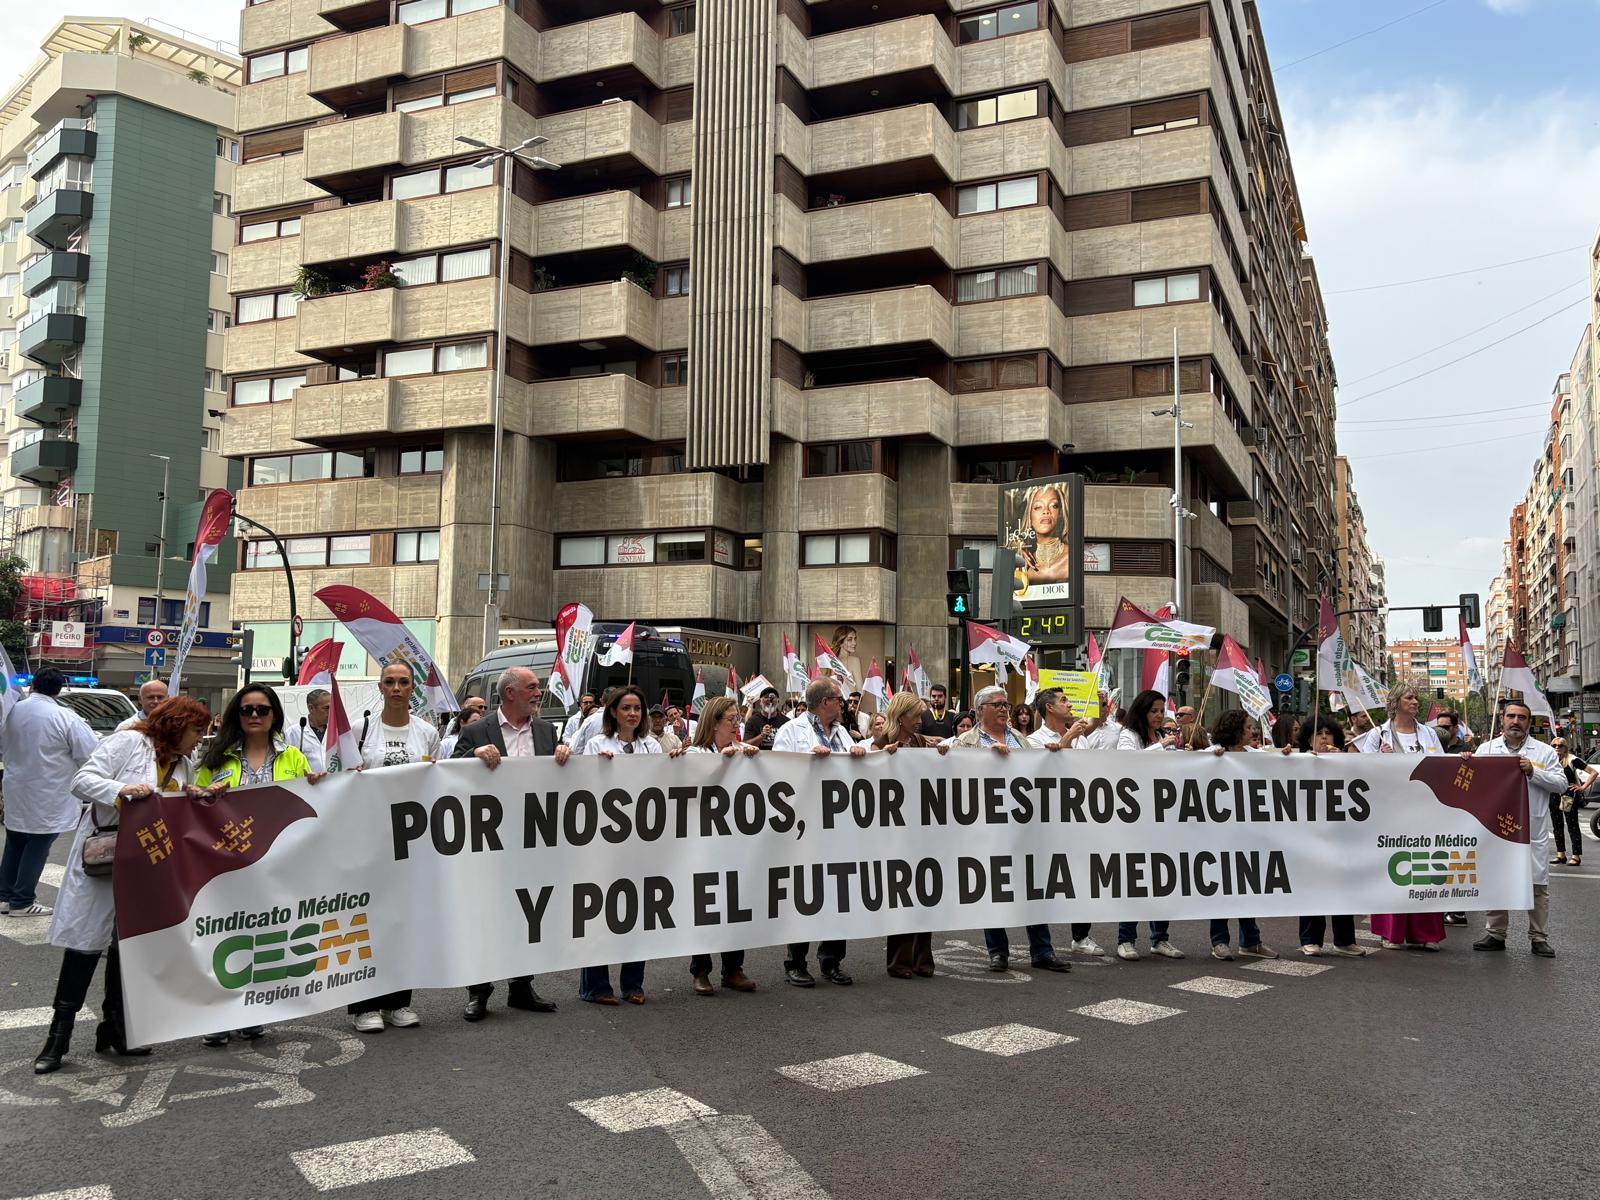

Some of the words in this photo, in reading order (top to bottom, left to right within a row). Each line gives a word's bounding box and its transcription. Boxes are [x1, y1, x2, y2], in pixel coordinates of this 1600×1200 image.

[1084, 563, 1099, 571] RALI
[1042, 584, 1066, 595] DIOR
[55, 632, 81, 641] PEGIRO
[149, 634, 162, 642] 30
[390, 794, 504, 861] POR
[523, 780, 806, 849] NOSOTROS,
[821, 778, 905, 829] POR
[920, 777, 1141, 825] NUESTROS
[1153, 777, 1371, 823] PACIENTES
[1377, 835, 1431, 848] Sindicato
[1435, 834, 1478, 847] Médico
[1387, 850, 1477, 886] CESM
[515, 885, 554, 944] Y
[572, 875, 676, 938] POR
[693, 870, 753, 926] EL
[768, 855, 943, 919] FUTURO
[958, 855, 1014, 905] DE
[1026, 853, 1076, 901] LA
[1090, 850, 1292, 899] MEDICINA
[1408, 888, 1437, 901] Región
[1439, 888, 1450, 898] de
[1451, 888, 1480, 898] Murcia
[195, 906, 291, 937] Sindicato
[297, 891, 371, 920] Médico
[212, 912, 373, 990] CESM
[244, 984, 300, 1006] Región
[304, 979, 323, 996] de
[326, 965, 377, 990] Murcia
